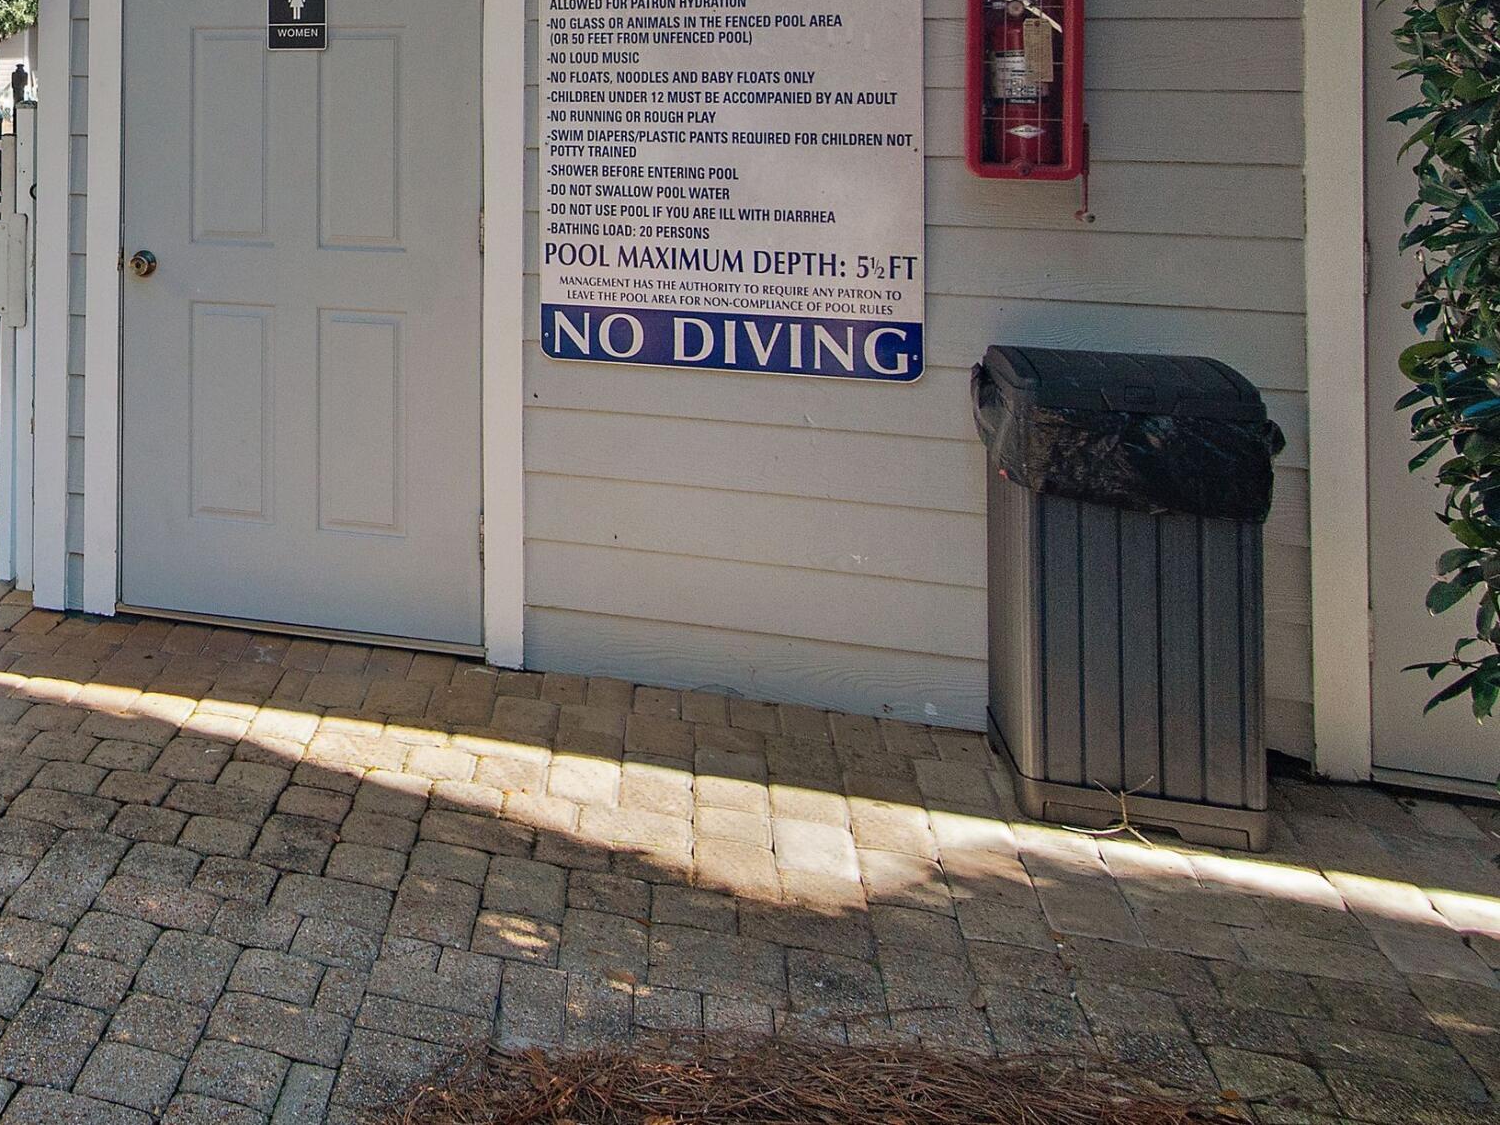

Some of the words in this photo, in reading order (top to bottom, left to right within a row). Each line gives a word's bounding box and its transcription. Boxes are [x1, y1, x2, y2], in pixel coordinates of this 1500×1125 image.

[569, 17, 605, 29] GLASS
[608, 17, 623, 29] OR
[626, 16, 680, 29] ANIMALS
[683, 16, 696, 28] IN
[699, 15, 721, 28] THE
[725, 15, 771, 28] FENCED
[774, 14, 806, 27] POOL
[808, 14, 842, 27] AREA
[277, 28, 318, 37] WOMEN
[550, 32, 568, 46] (OR
[571, 32, 585, 44] 50
[587, 32, 614, 44] FEET
[617, 31, 649, 44] FROM
[652, 31, 715, 44] UNFENCED
[718, 30, 752, 45] POOL)
[569, 51, 598, 64] LOUD
[602, 51, 639, 64] MUSIC
[569, 71, 612, 84] FLOATS,
[616, 71, 669, 83] NOODLES
[671, 71, 698, 83] AND
[701, 71, 734, 83] BABY
[737, 71, 780, 84] FLOATS
[783, 71, 815, 84] ONLY
[608, 90, 647, 103] UNDER
[651, 91, 664, 103] 12
[667, 91, 702, 103] MUST
[704, 91, 719, 103] BE
[722, 91, 812, 104] ACCOMPANIED
[815, 91, 832, 104] BY
[834, 91, 853, 104] AN
[856, 92, 897, 105] ADULT
[569, 110, 622, 122] RUNNING
[625, 110, 640, 123] OR
[644, 110, 683, 123] ROUGH
[687, 111, 716, 123] PLAY
[587, 129, 686, 143] DIAPERS/PLASTIC
[689, 131, 728, 144] PANTS
[731, 131, 791, 145] REQUIRED
[794, 132, 817, 145] FOR
[821, 132, 882, 146] CHILDREN
[886, 133, 913, 146] NOT
[550, 144, 585, 157] POTTY
[587, 145, 637, 158] TRAINED
[602, 165, 644, 178] BEFORE
[647, 166, 705, 179] ENTERING
[708, 167, 739, 180] POOL
[569, 183, 592, 196] NOT
[595, 184, 653, 198] SWALLOW
[656, 186, 686, 199] POOL
[688, 186, 730, 200] WATER
[569, 203, 592, 216] NOT
[595, 204, 617, 216] USE
[620, 204, 650, 218] POOL
[652, 205, 662, 218] IF
[665, 206, 689, 219] YOU
[692, 207, 716, 219] ARE
[719, 207, 736, 220] ILL
[737, 208, 770, 221] WITH
[774, 209, 836, 223] DIARRHEA
[602, 223, 636, 237] LOAD:
[639, 225, 652, 237] 20
[656, 225, 710, 240] PERSONS
[545, 242, 610, 267] POOL
[617, 245, 743, 273] MAXIMUM
[753, 250, 845, 277] DEPTH:
[889, 255, 917, 280] FT
[559, 276, 630, 288] MANAGEMENT
[633, 278, 654, 289] HAS
[656, 279, 676, 290] THE
[678, 281, 741, 293] AUTHORITY
[743, 283, 759, 294] TO
[762, 284, 809, 297] REQUIRE
[812, 287, 835, 297] ANY
[837, 288, 882, 299] PATRON
[885, 290, 902, 301] TO
[567, 289, 594, 300] LEAVE
[597, 291, 617, 301] THE
[620, 292, 648, 303] POOL
[651, 294, 677, 304] AREA
[679, 295, 701, 306] FOR
[703, 296, 803, 311] NON-COMPLIANCE
[806, 301, 822, 312] OF
[825, 302, 856, 314] POOL
[859, 303, 893, 315] RULES
[554, 310, 644, 358] NO
[673, 317, 908, 374] DIVING
